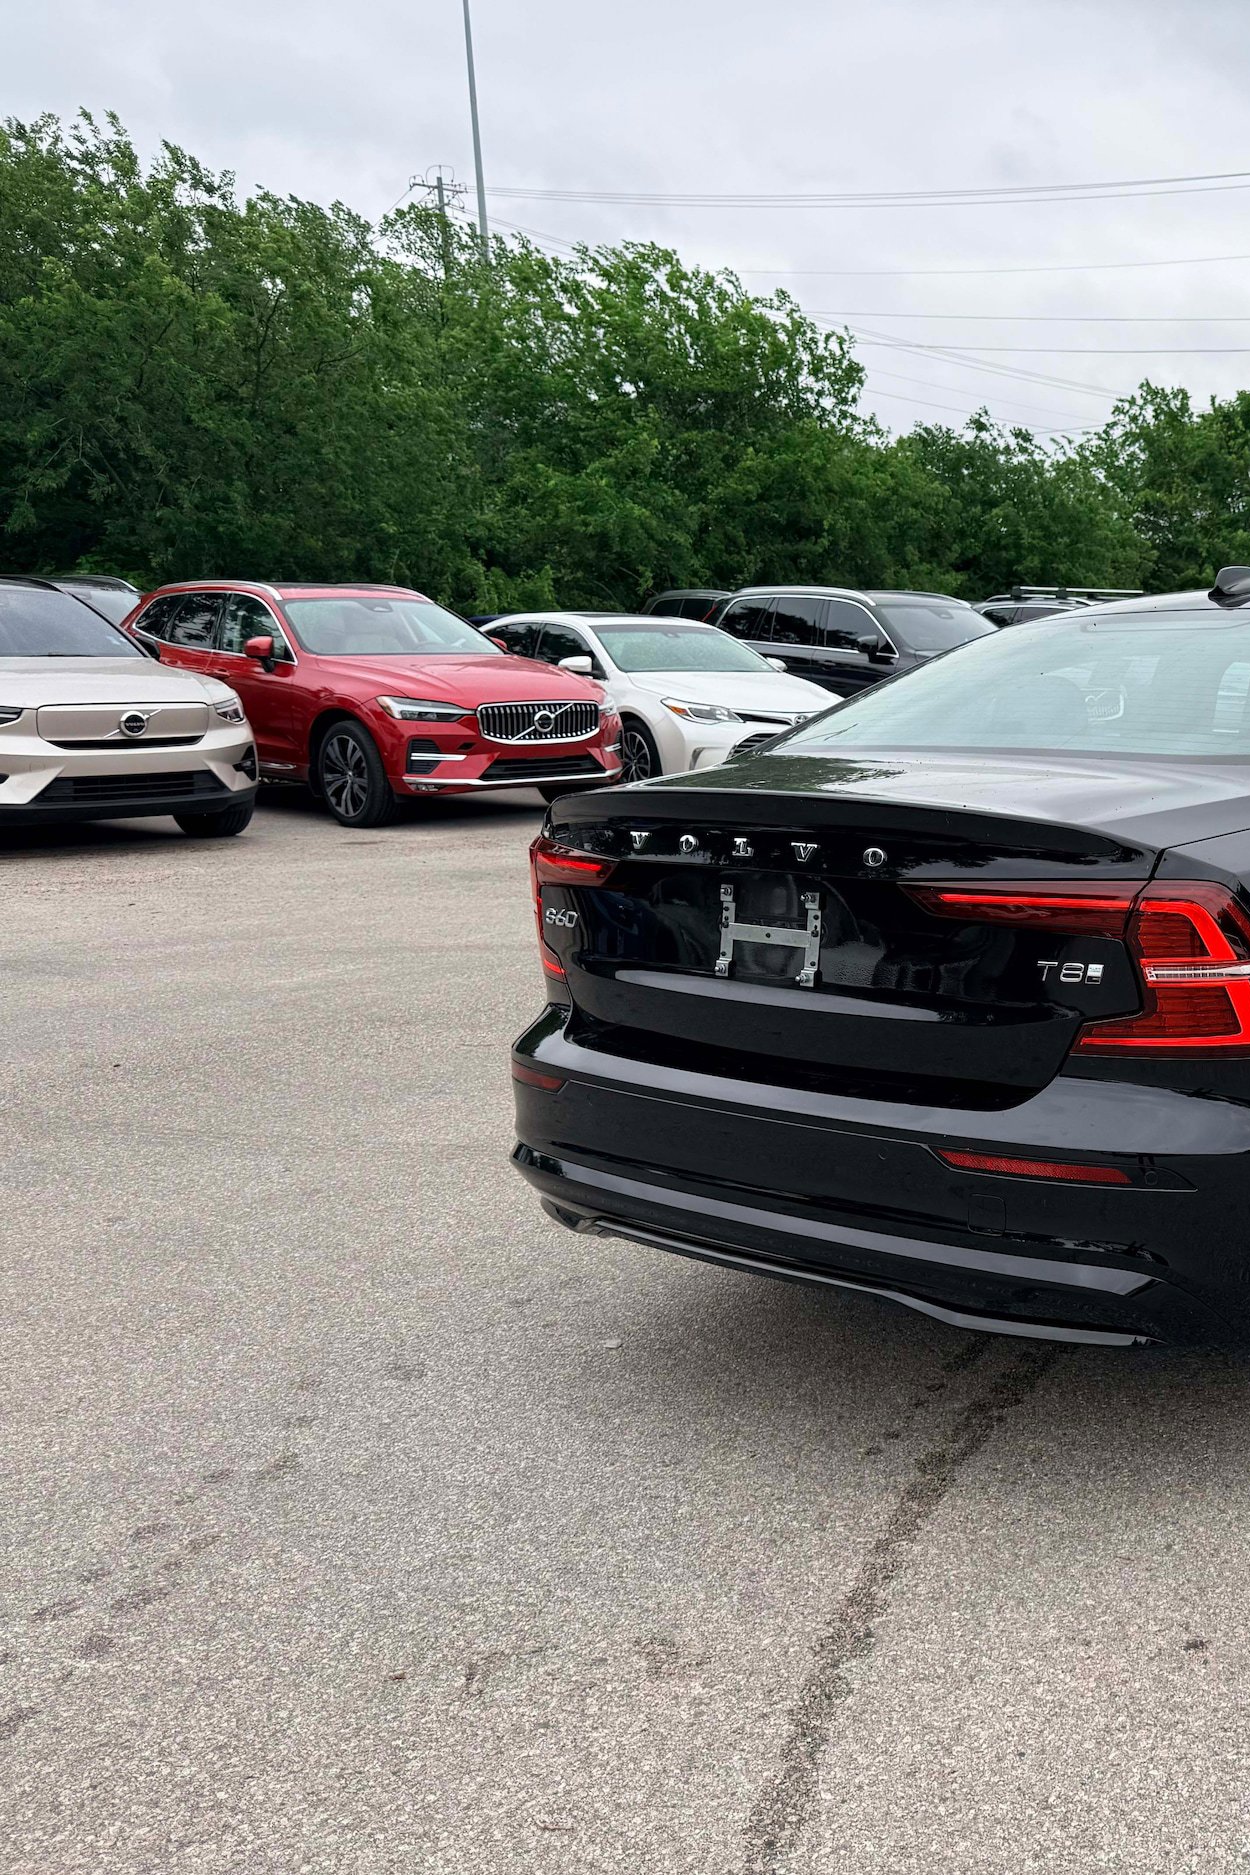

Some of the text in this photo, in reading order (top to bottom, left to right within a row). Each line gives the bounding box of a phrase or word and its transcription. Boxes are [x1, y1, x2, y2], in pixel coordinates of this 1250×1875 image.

[629, 831, 888, 868] VOLVO
[545, 907, 579, 928] S60
[1037, 960, 1085, 983] T8
